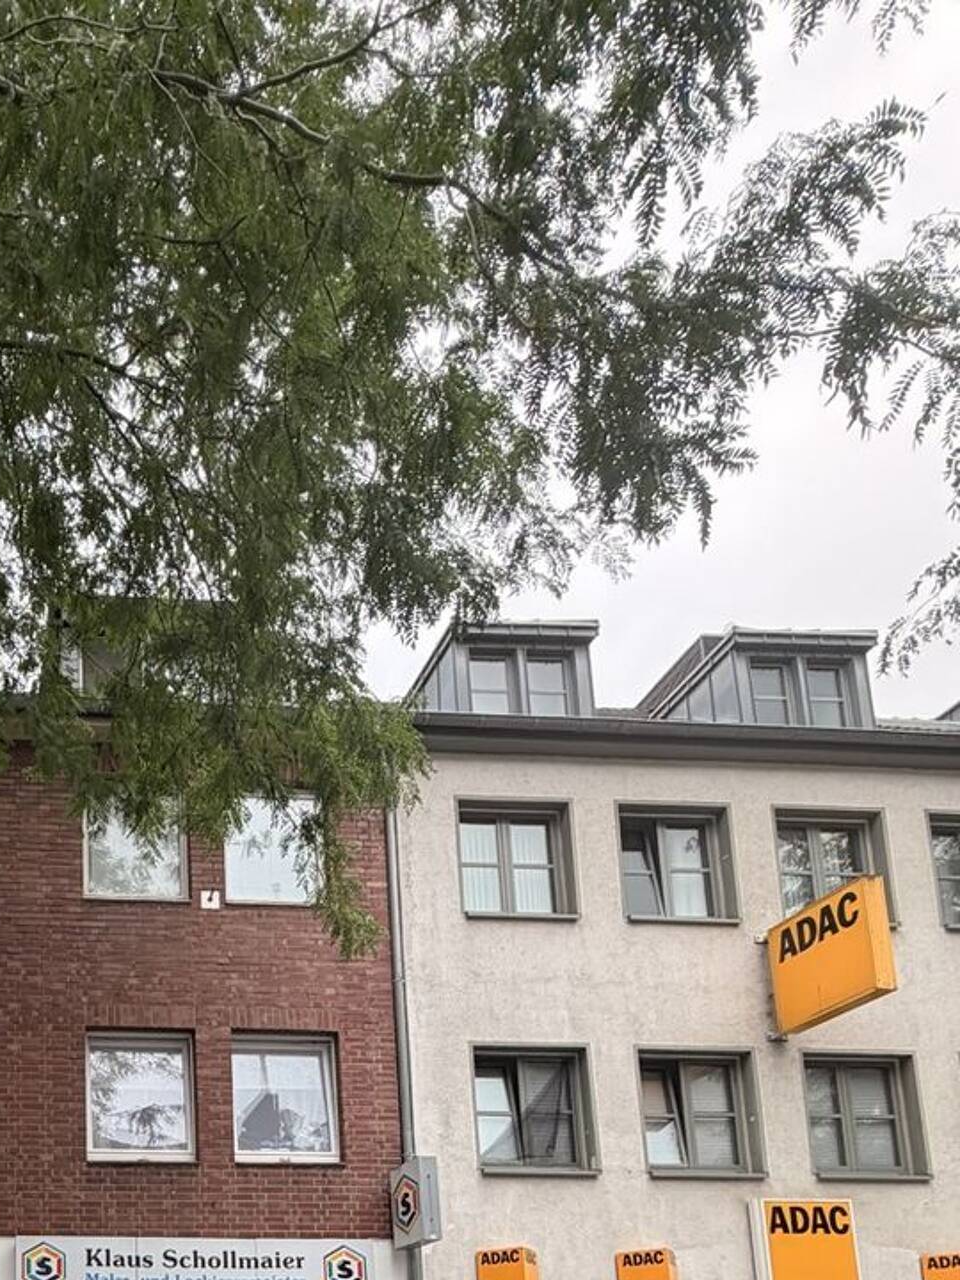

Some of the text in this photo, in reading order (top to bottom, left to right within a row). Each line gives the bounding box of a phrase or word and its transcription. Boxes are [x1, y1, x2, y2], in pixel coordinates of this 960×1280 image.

[779, 892, 859, 964] ADAC
[401, 1193, 411, 1216] S
[771, 1206, 850, 1234] ADAC
[35, 1257, 53, 1275] S
[85, 1249, 305, 1270] Klaus Schollmaier
[481, 1249, 520, 1264] ADAC
[623, 1251, 664, 1266] ADAC
[927, 1255, 960, 1269] ADA
[337, 1260, 354, 1279] S
